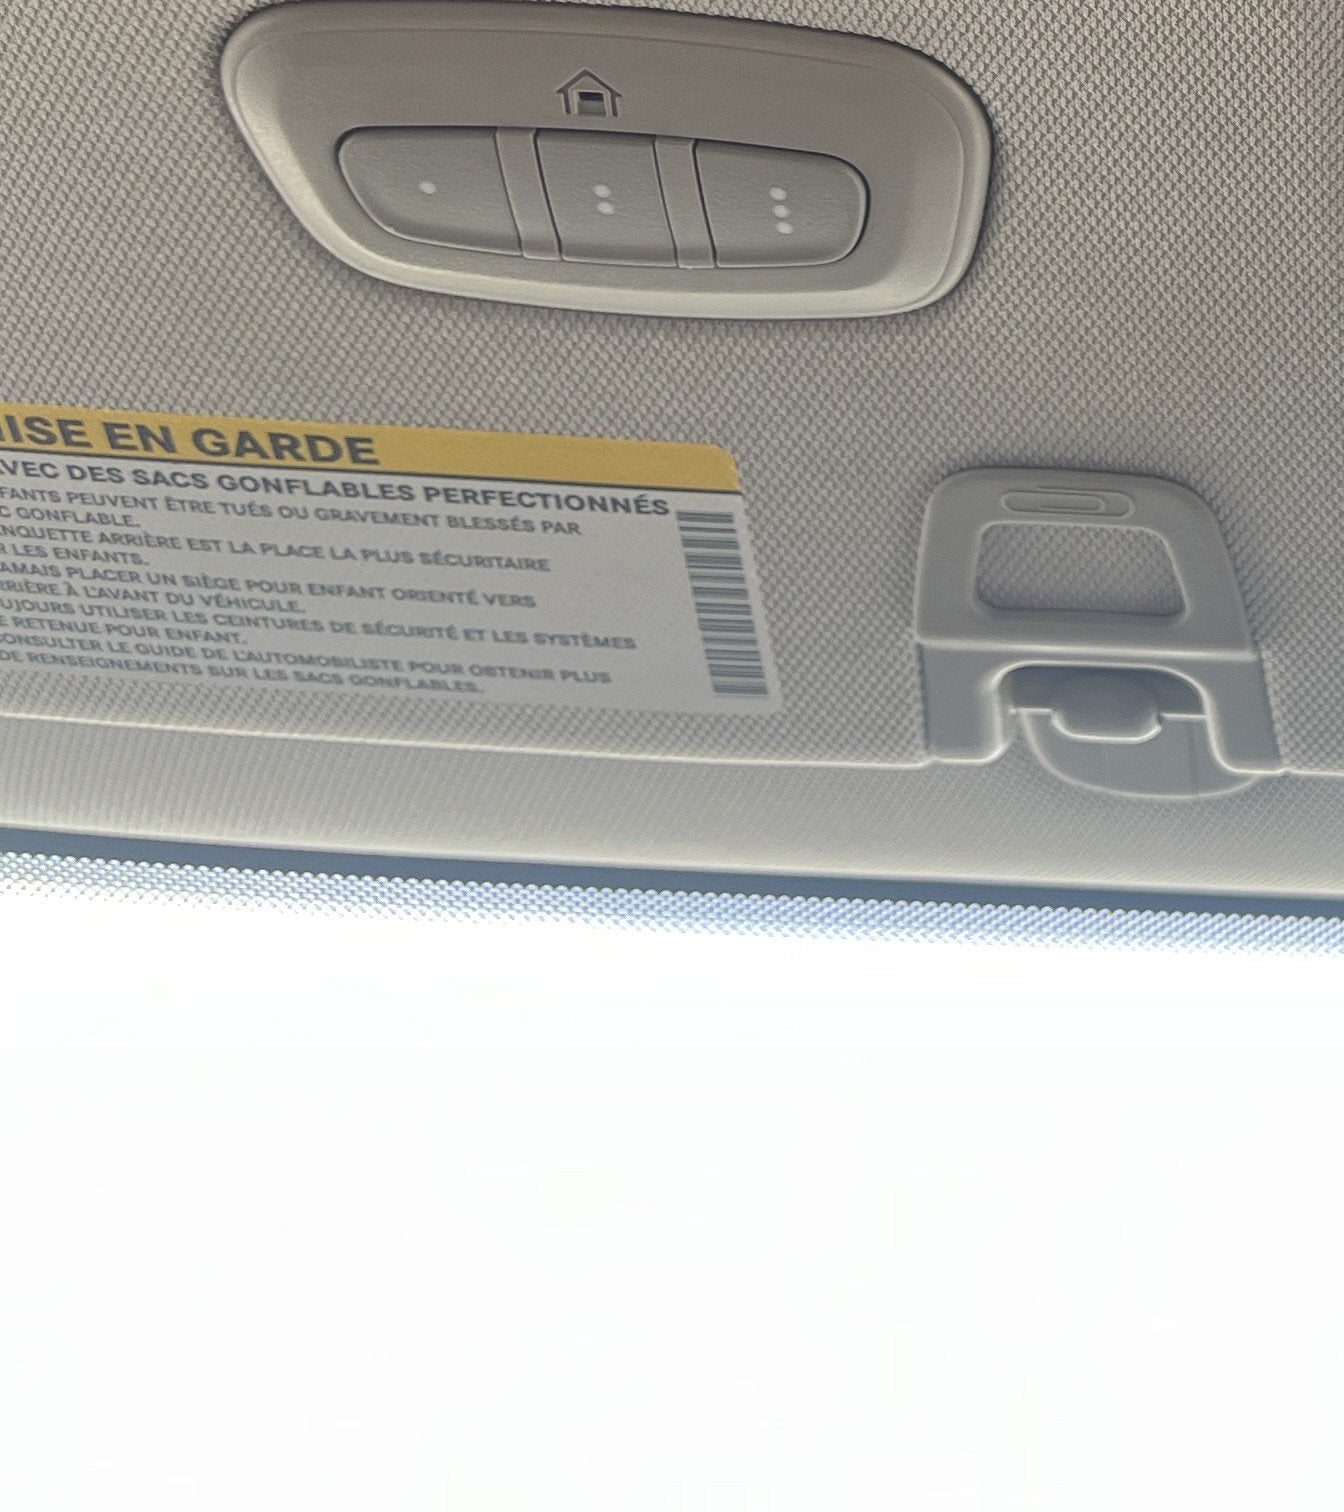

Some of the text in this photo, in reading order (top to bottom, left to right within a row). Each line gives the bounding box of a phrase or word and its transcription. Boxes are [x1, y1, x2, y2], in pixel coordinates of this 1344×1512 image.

[0, 415, 380, 465] ISE EN GARDE
[66, 464, 124, 483] DES
[132, 469, 209, 489] SACS
[217, 474, 415, 501] GONFLABLES
[423, 486, 669, 516] PERFECTIONNÉS
[66, 491, 157, 509] PEUVENT
[165, 495, 216, 514] ÊTRE
[219, 500, 272, 517] TUÉS
[278, 505, 308, 519] OU
[314, 507, 438, 527] GRAVEMENT
[447, 515, 535, 532] BLESSÉS
[542, 520, 581, 535] PAR
[12, 543, 48, 558] LES
[98, 530, 182, 550] ARRIÈRE
[187, 538, 225, 553] EST
[229, 541, 256, 555] LA
[259, 543, 325, 559] PLACE
[329, 547, 357, 560] LA
[361, 549, 414, 564] PLUS
[66, 566, 142, 583] PLACER
[147, 572, 177, 586] UN
[182, 573, 241, 591] SIÈGE
[245, 580, 302, 595] POUR
[306, 583, 386, 599] ENFANT
[483, 593, 536, 608] VERS
[0, 632, 103, 651] ONSULTER
